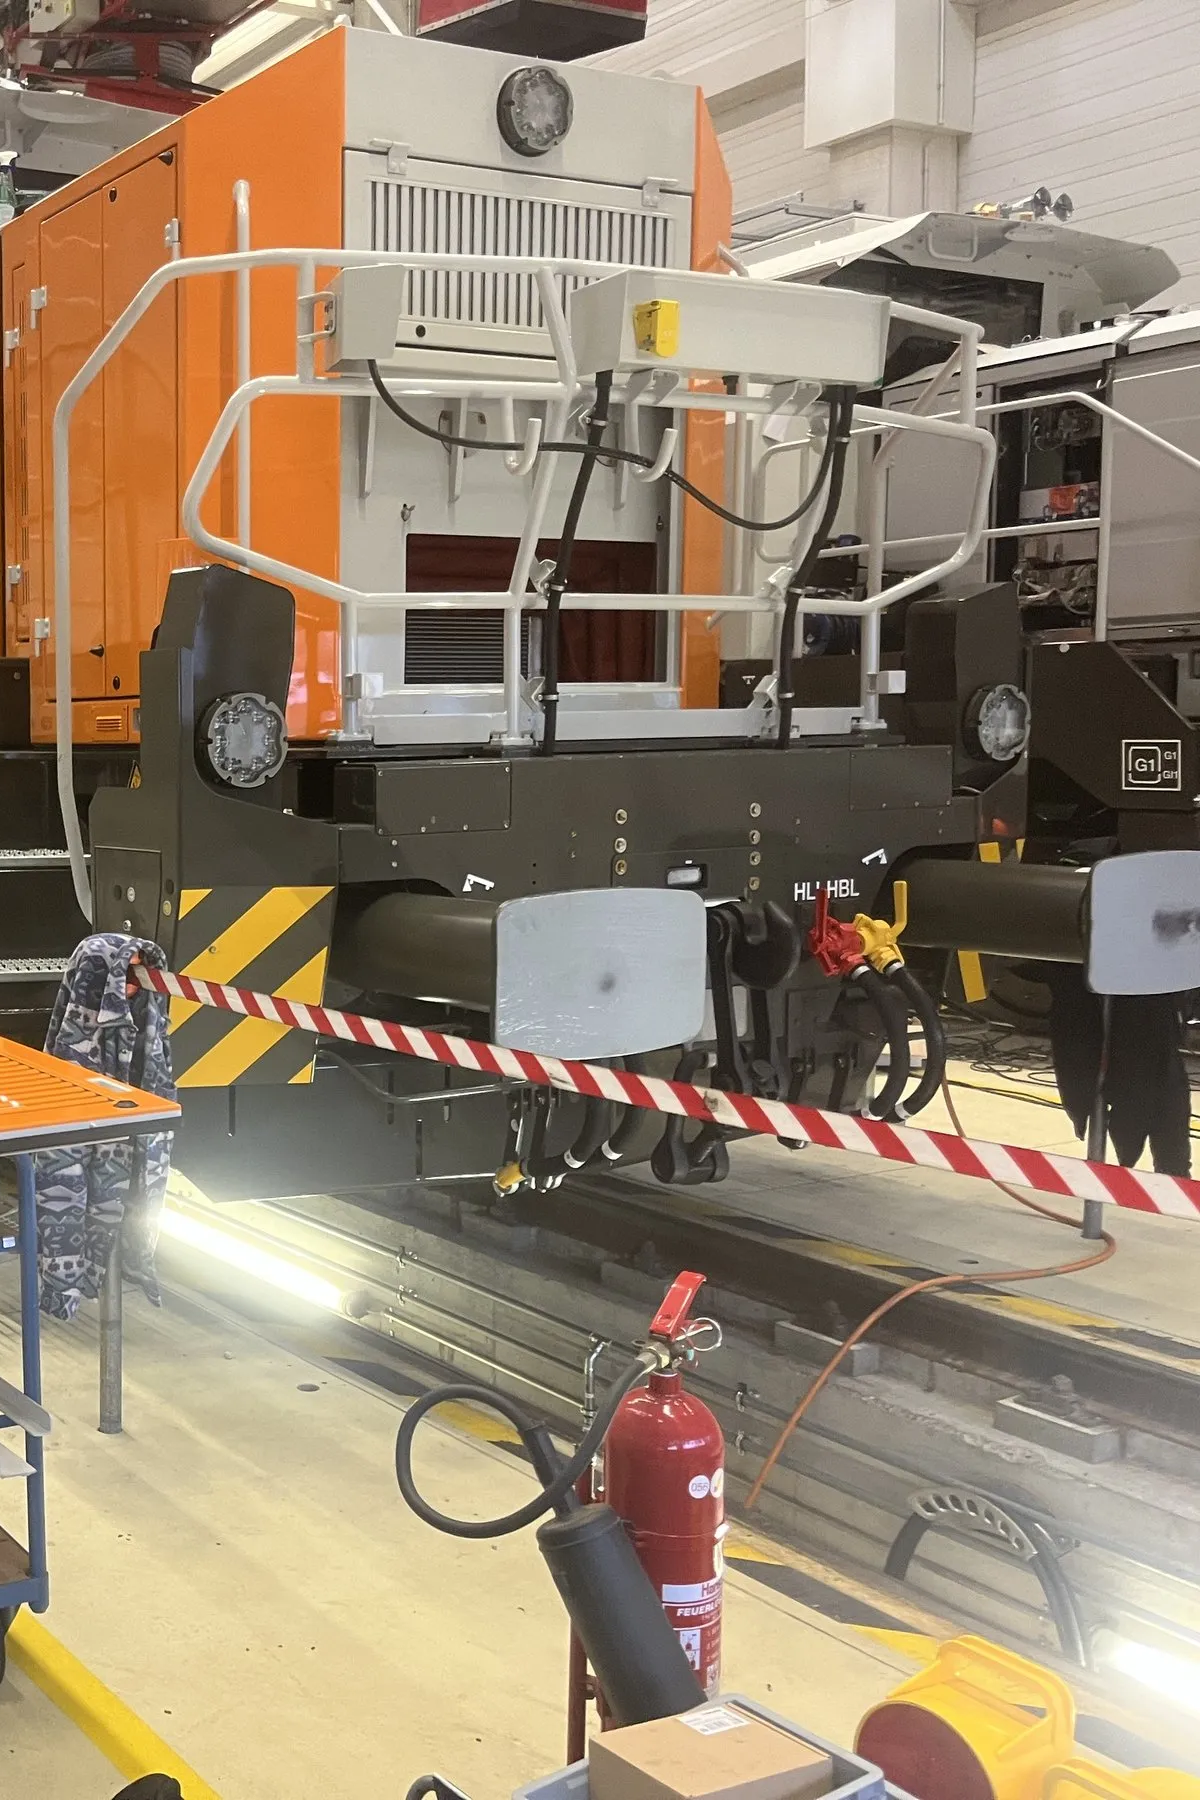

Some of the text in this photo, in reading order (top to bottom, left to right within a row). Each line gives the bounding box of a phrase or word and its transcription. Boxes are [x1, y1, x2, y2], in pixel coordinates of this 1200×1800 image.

[1164, 751, 1177, 760] G1
[1135, 758, 1155, 772] G1
[826, 878, 860, 899] HBL
